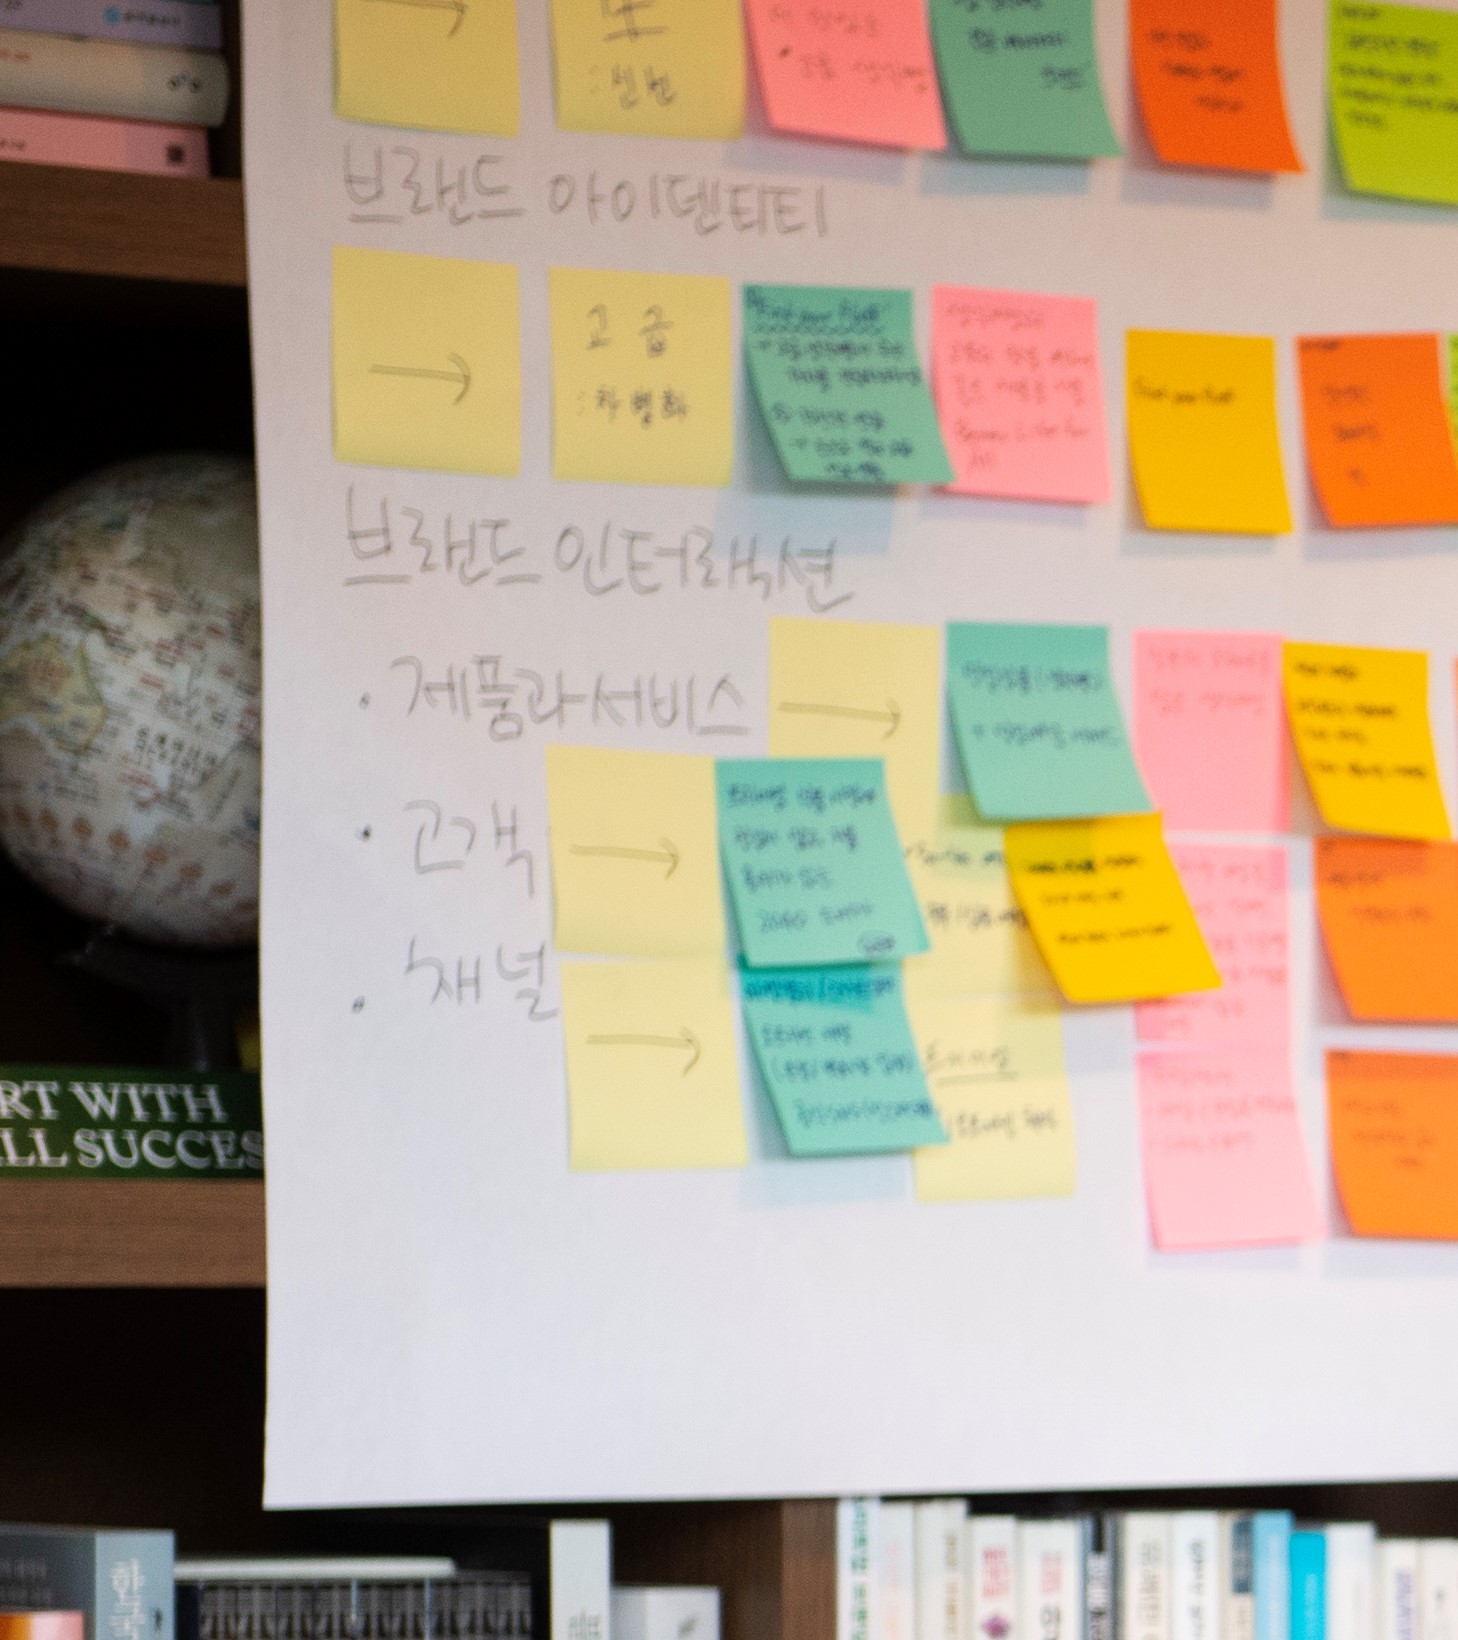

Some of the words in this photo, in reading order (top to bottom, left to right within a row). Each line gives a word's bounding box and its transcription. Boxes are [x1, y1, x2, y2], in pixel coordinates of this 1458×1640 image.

[345, 144, 525, 225] 브랜드
[548, 169, 829, 237] 아이덴티티
[344, 482, 542, 588] 브랜드
[554, 520, 855, 614] 인터랙션
[402, 799, 535, 899] 고객
[402, 935, 559, 1023] 채널
[0, 1127, 68, 1168] LL
[67, 1081, 229, 1124] WITH
